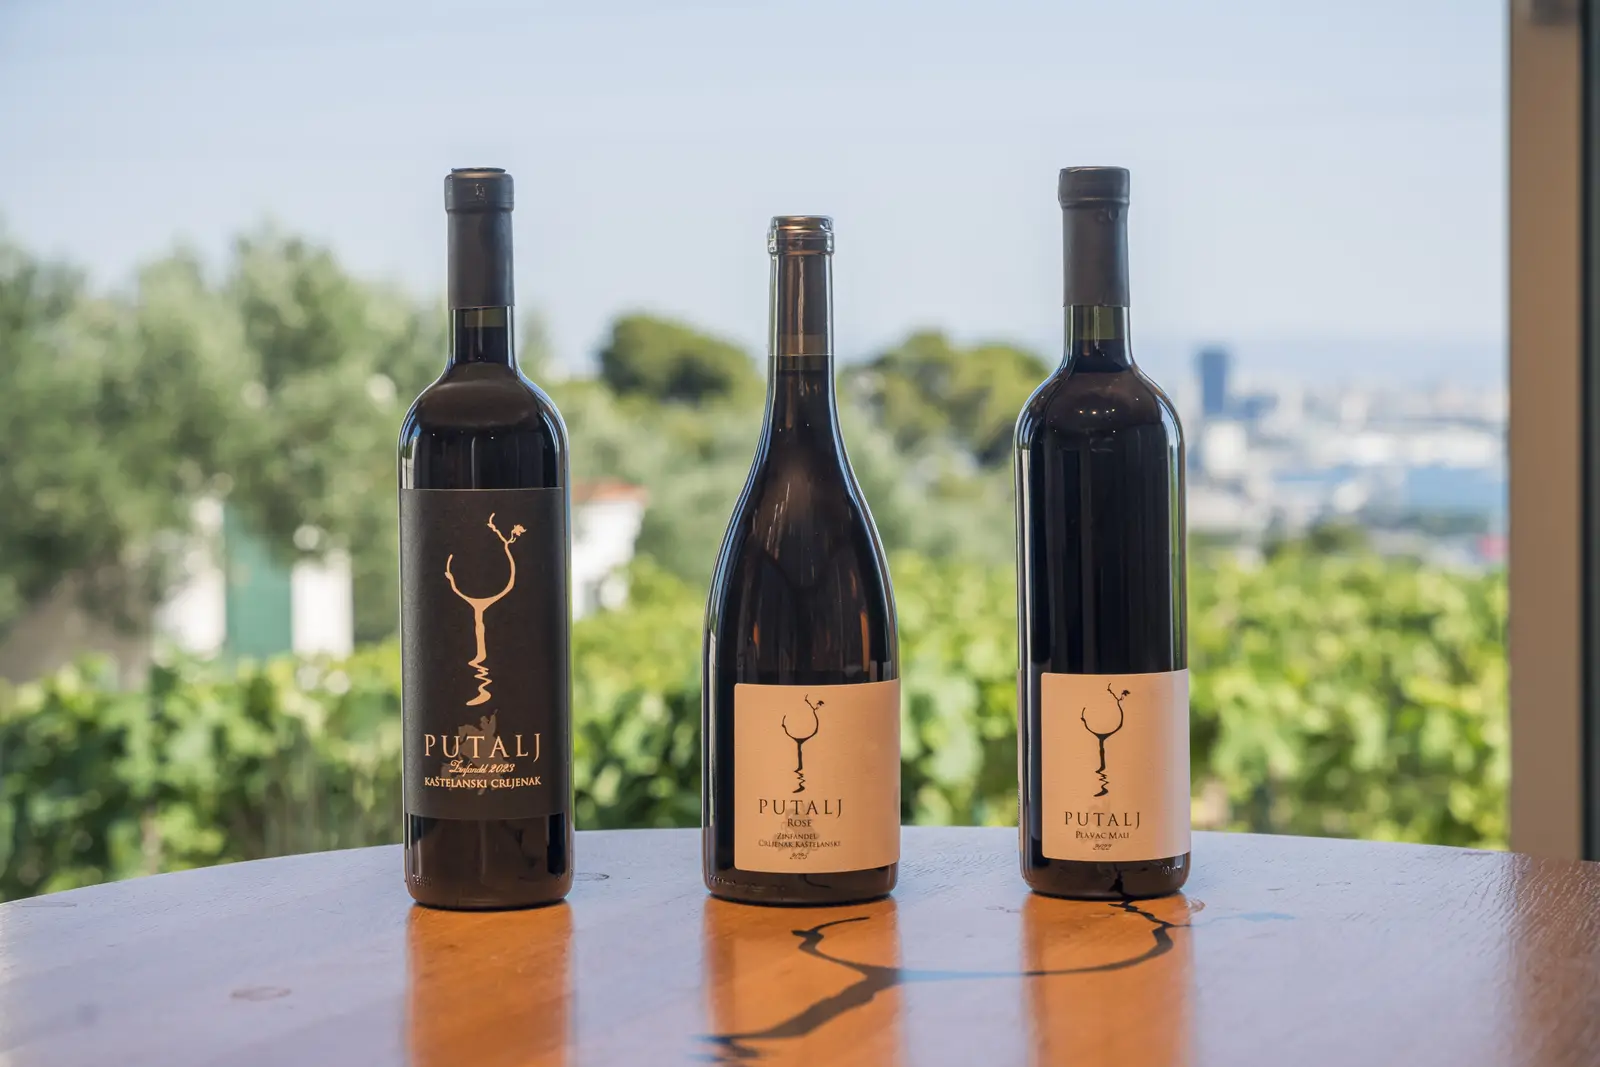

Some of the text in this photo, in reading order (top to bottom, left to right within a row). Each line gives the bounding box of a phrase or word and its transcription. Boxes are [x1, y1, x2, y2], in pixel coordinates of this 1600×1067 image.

[424, 733, 541, 762] PUTALJ
[448, 760, 516, 776] Zinfandel 2023
[424, 776, 542, 789] KAŠTELANSKI CRLJENAK
[758, 798, 842, 818] PUTALJ
[1065, 811, 1140, 830] PUTALJ
